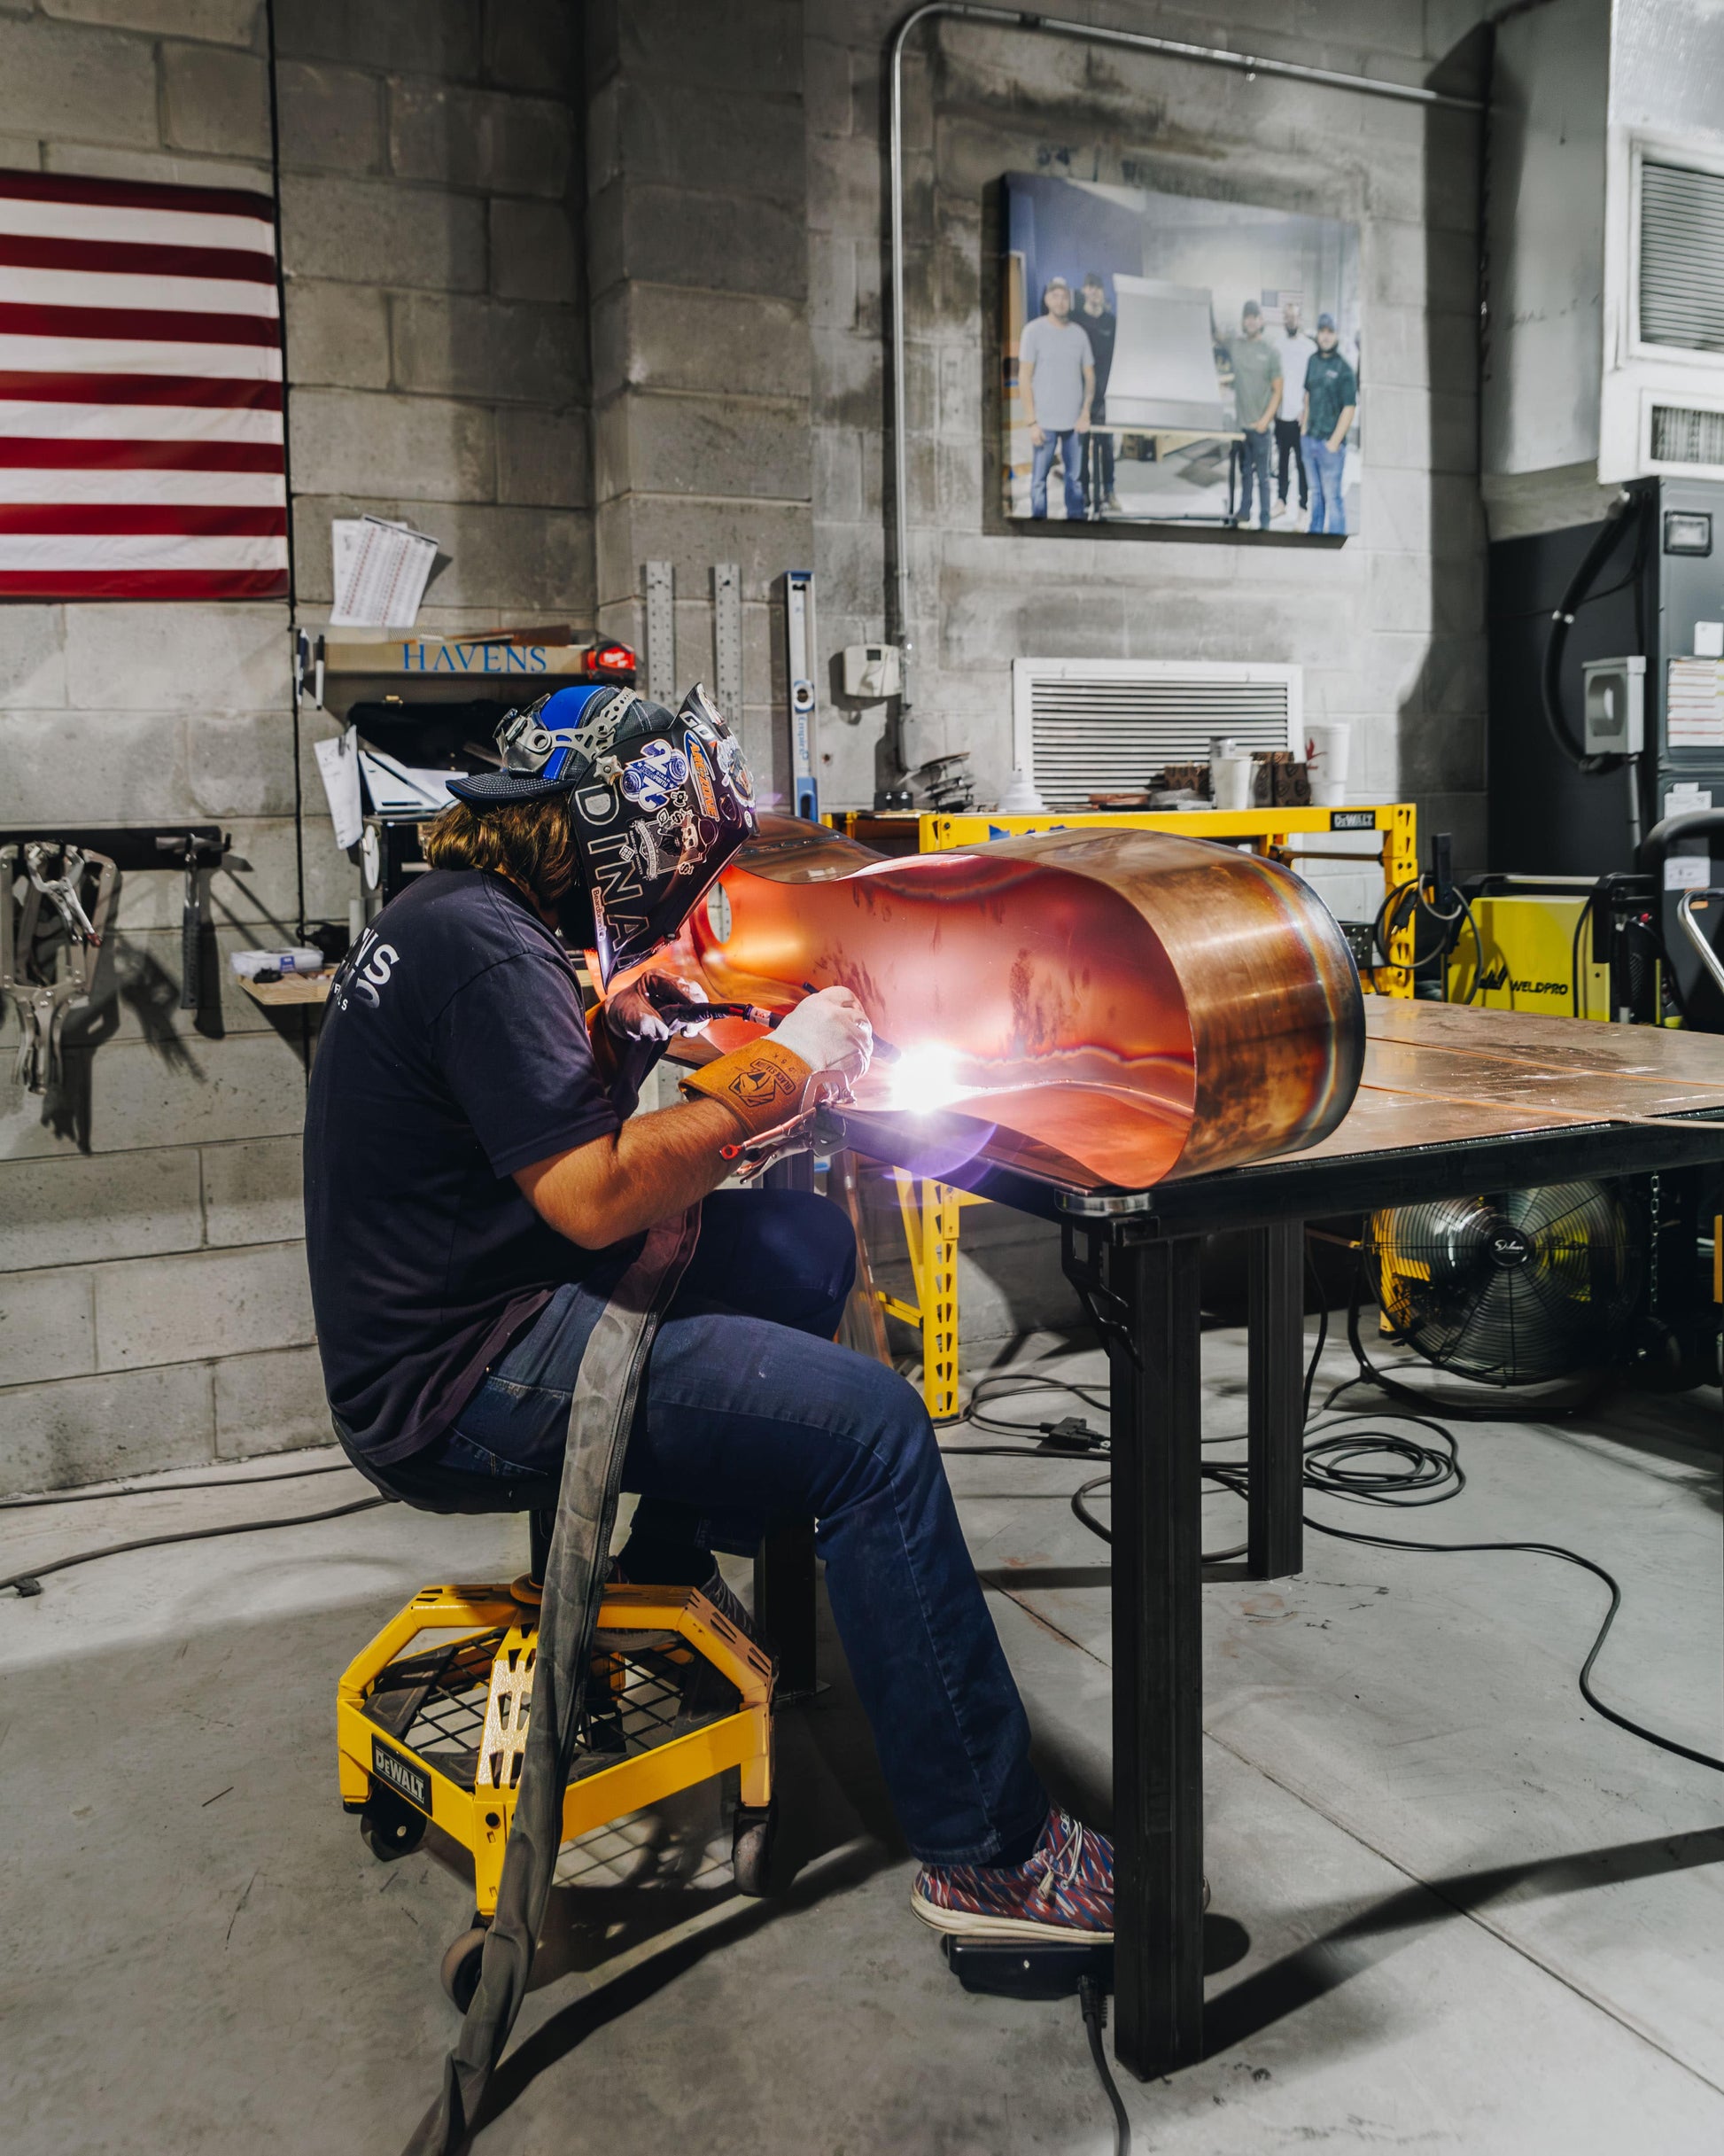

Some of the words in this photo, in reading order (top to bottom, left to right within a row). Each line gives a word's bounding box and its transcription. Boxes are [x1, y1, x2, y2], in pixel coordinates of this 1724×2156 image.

[403, 643, 547, 673] HAVENS
[687, 739, 717, 816] ARC-ZONE
[1333, 812, 1374, 829] DEWALT
[575, 783, 650, 969] DINA
[1509, 978, 1569, 996] WELDPRO
[375, 1746, 424, 1804] DEWALT
